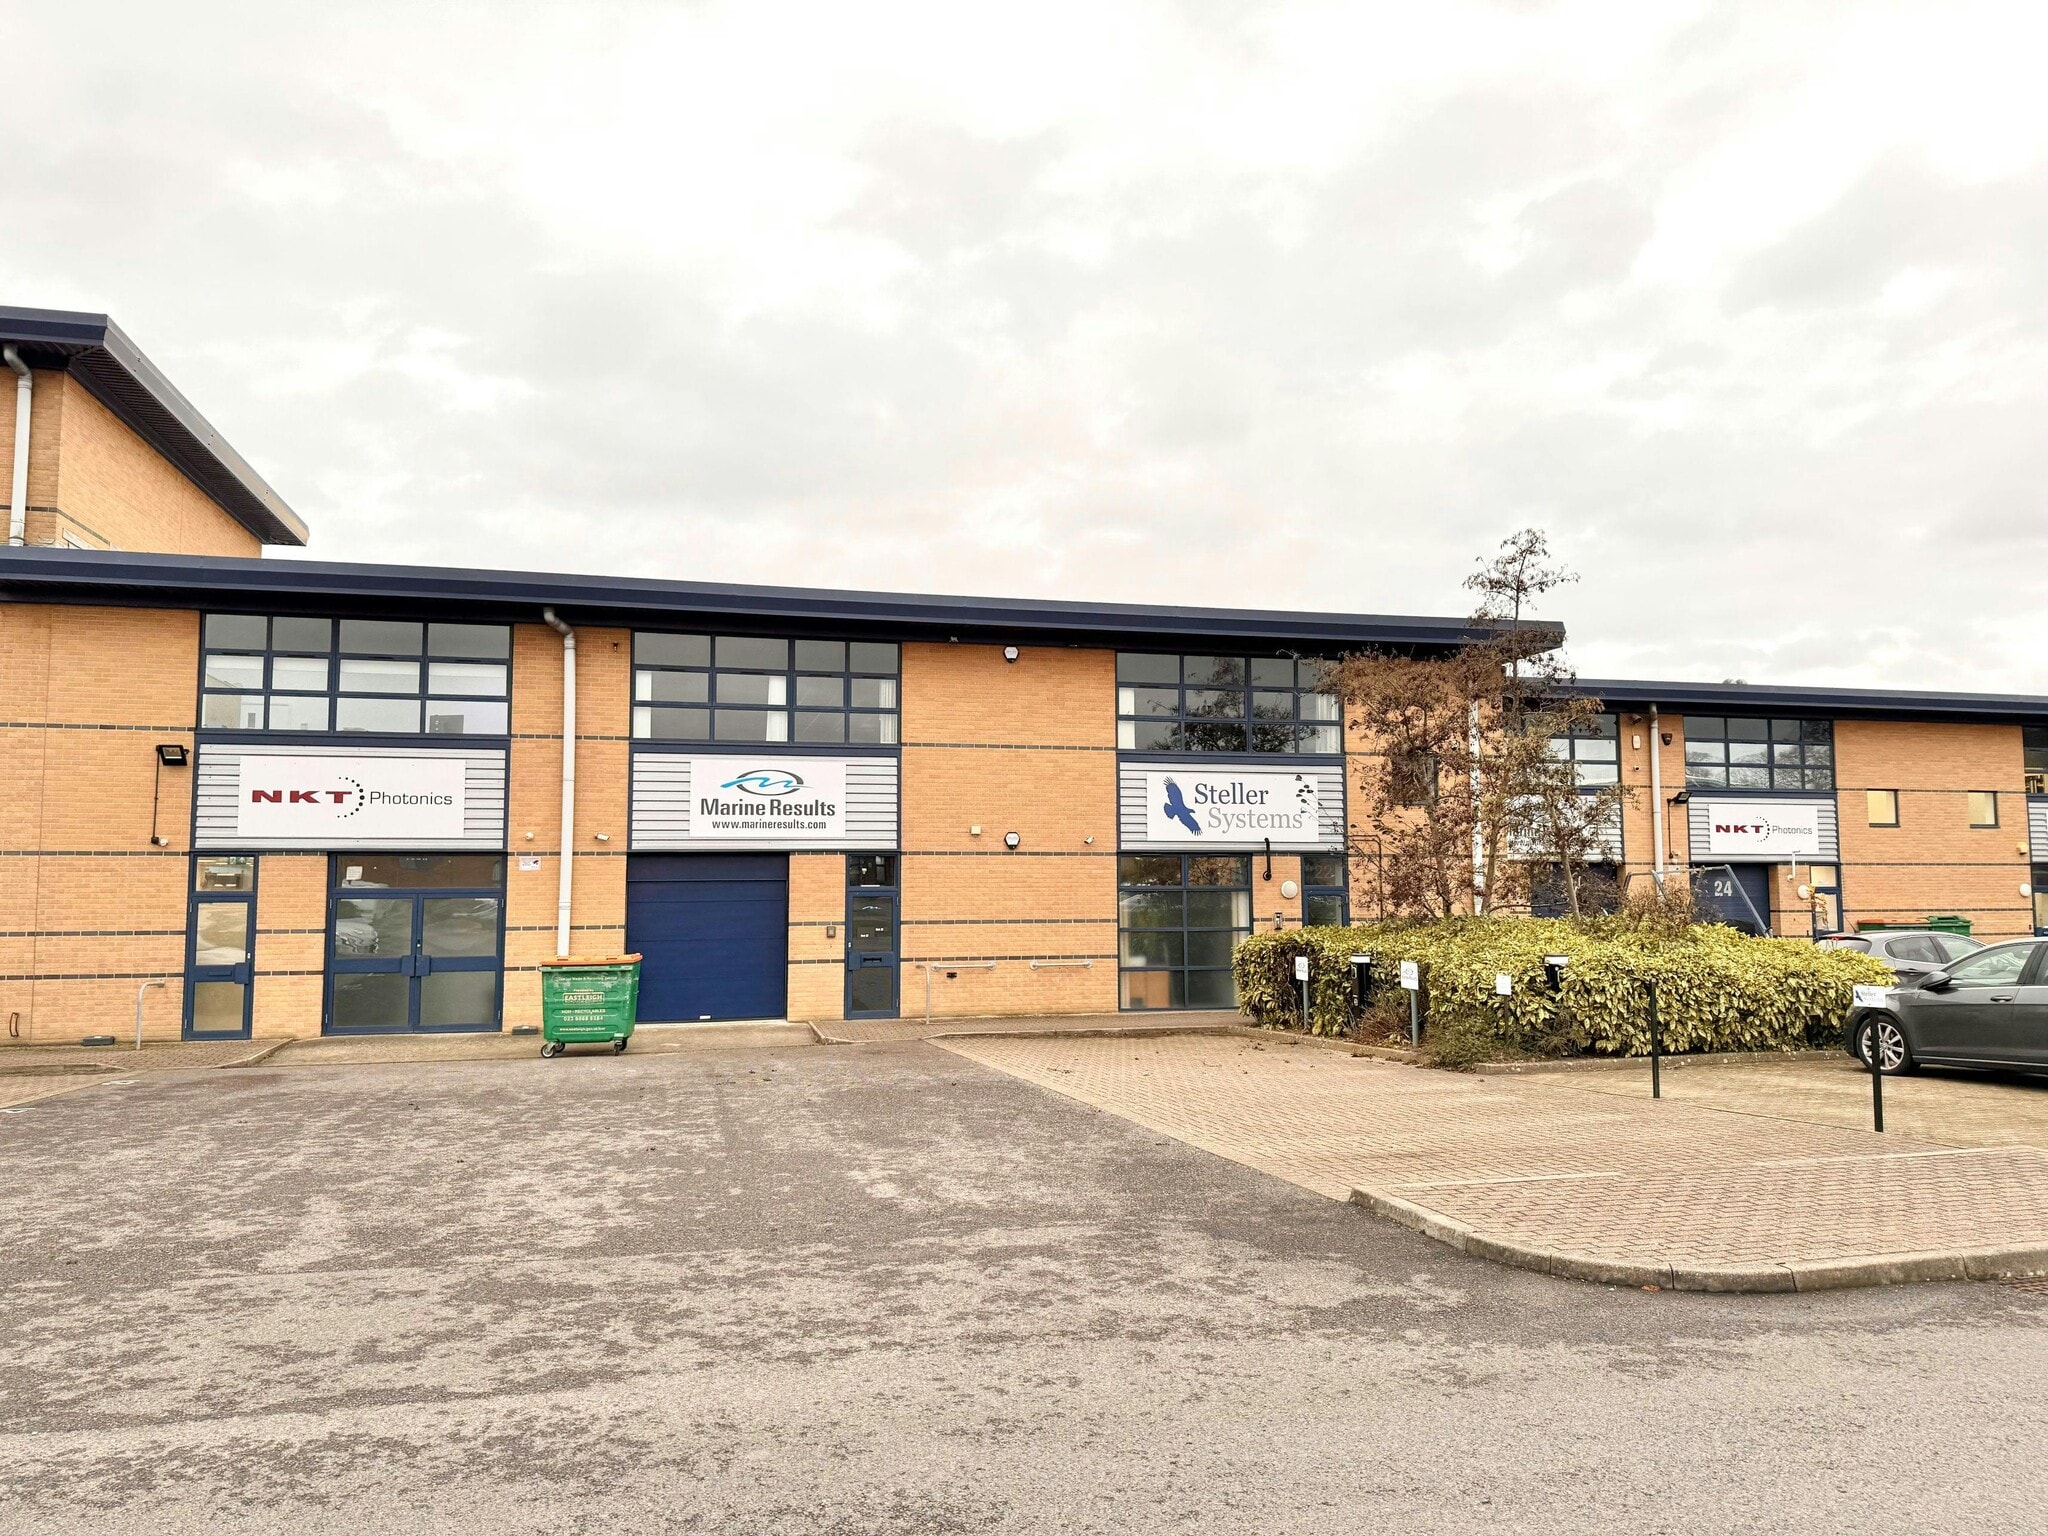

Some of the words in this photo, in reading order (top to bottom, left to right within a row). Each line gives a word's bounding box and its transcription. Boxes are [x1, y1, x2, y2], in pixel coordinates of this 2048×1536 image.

[252, 790, 352, 803] NKT
[370, 791, 453, 805] Photonics
[1194, 782, 1269, 804] Steller
[701, 798, 765, 816] Marine
[770, 799, 836, 816] Results
[712, 819, 827, 830] www.marineresults.com
[1208, 807, 1302, 833] Systems
[1715, 825, 1764, 833] NKT
[1772, 825, 1812, 835] Photonics
[1714, 880, 1733, 897] 24
